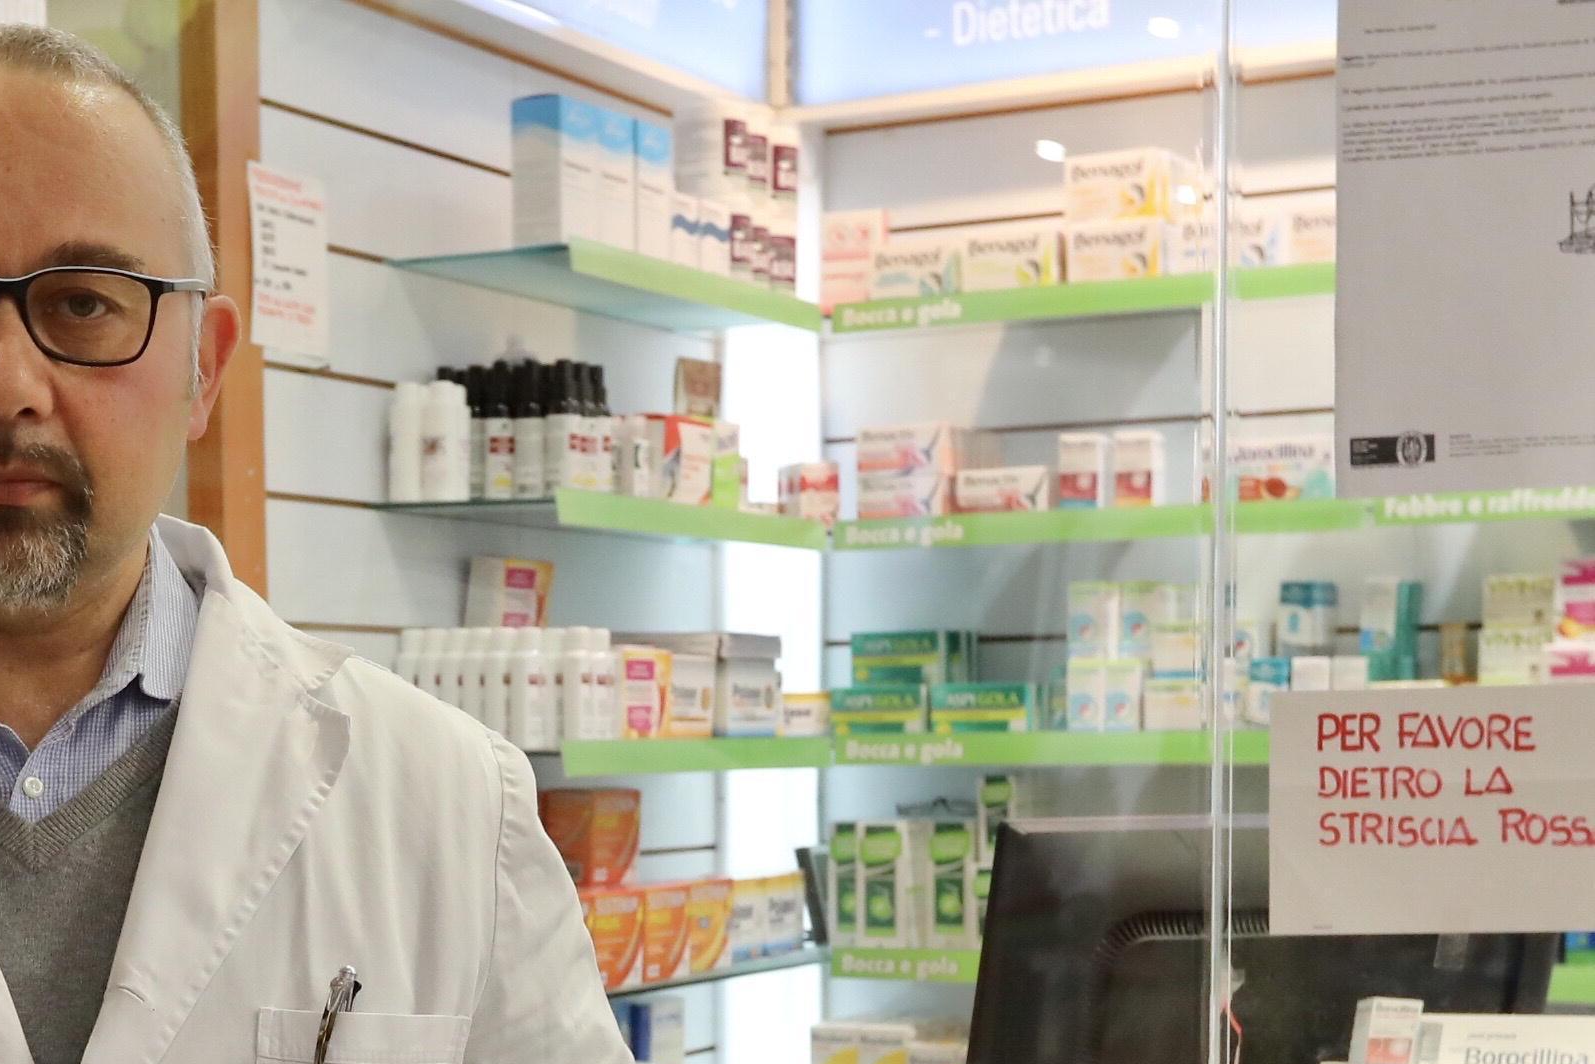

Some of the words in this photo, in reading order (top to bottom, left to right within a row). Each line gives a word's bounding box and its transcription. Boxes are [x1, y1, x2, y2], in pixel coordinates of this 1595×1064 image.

[917, 299, 962, 328] gola
[1317, 712, 1381, 752] PER
[1398, 712, 1536, 752] FAVORE
[1318, 766, 1442, 800] DIETRO
[1464, 766, 1514, 797] LA
[1318, 811, 1479, 848] STRISCIA
[1498, 807, 1595, 847] ROSS
